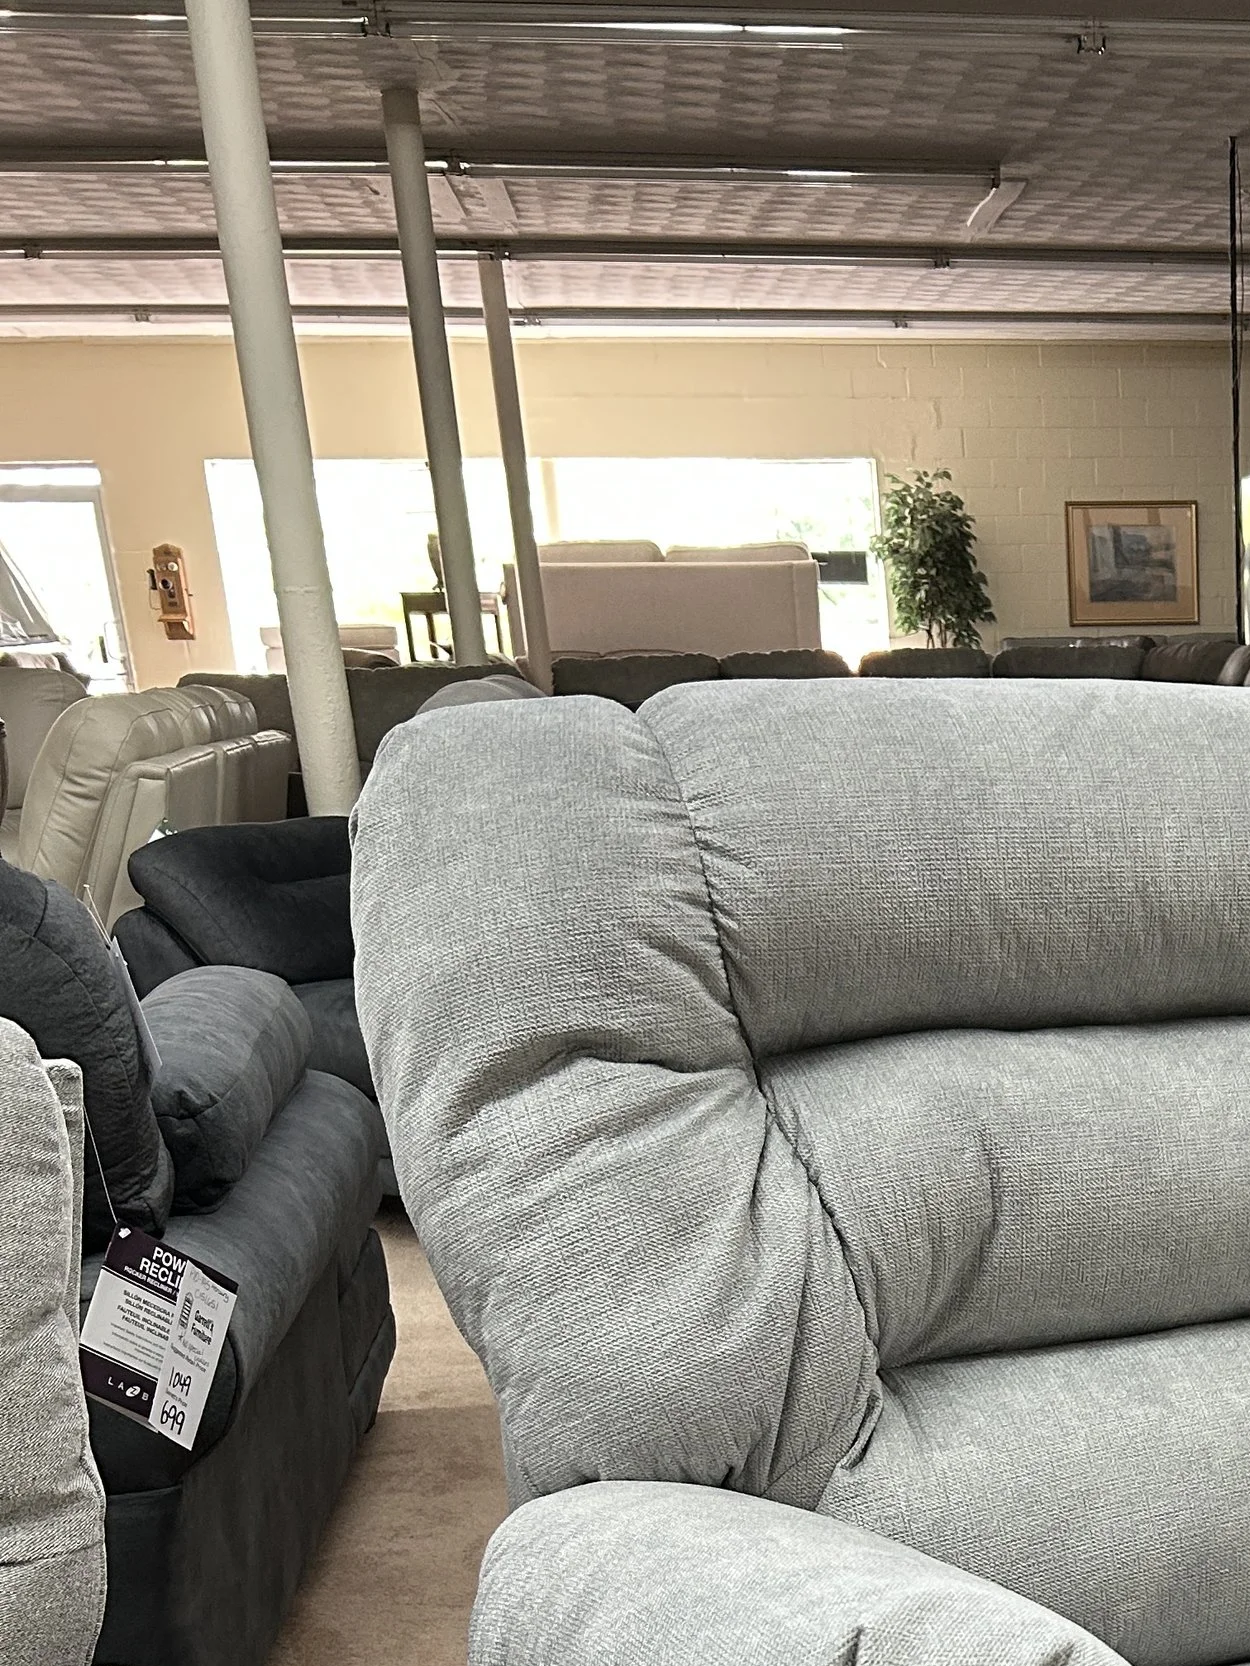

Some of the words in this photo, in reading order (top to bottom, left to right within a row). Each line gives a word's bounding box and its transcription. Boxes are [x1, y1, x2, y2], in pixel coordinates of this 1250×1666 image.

[146, 1276, 173, 1294] RECLINER
[168, 1366, 192, 1397] 1049
[160, 1399, 186, 1436] 699
